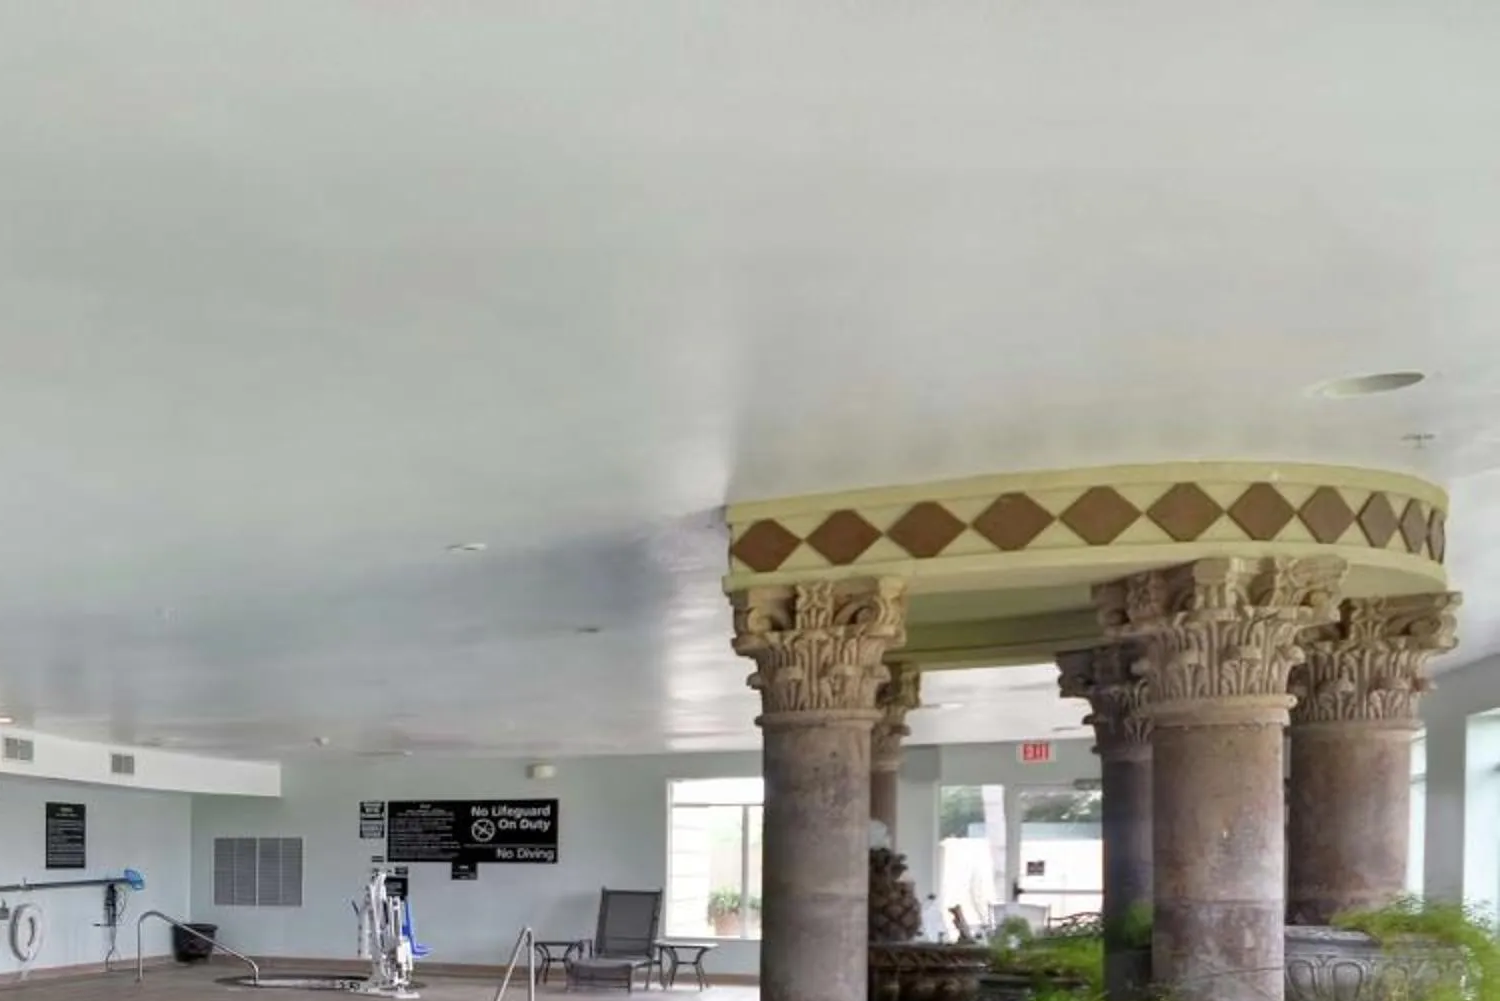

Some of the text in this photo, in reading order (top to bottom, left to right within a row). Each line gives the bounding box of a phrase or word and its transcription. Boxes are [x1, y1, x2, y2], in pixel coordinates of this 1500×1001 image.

[470, 804, 551, 820] No Lifeguard
[497, 818, 551, 833] On Duty
[496, 847, 555, 862] No Diving
